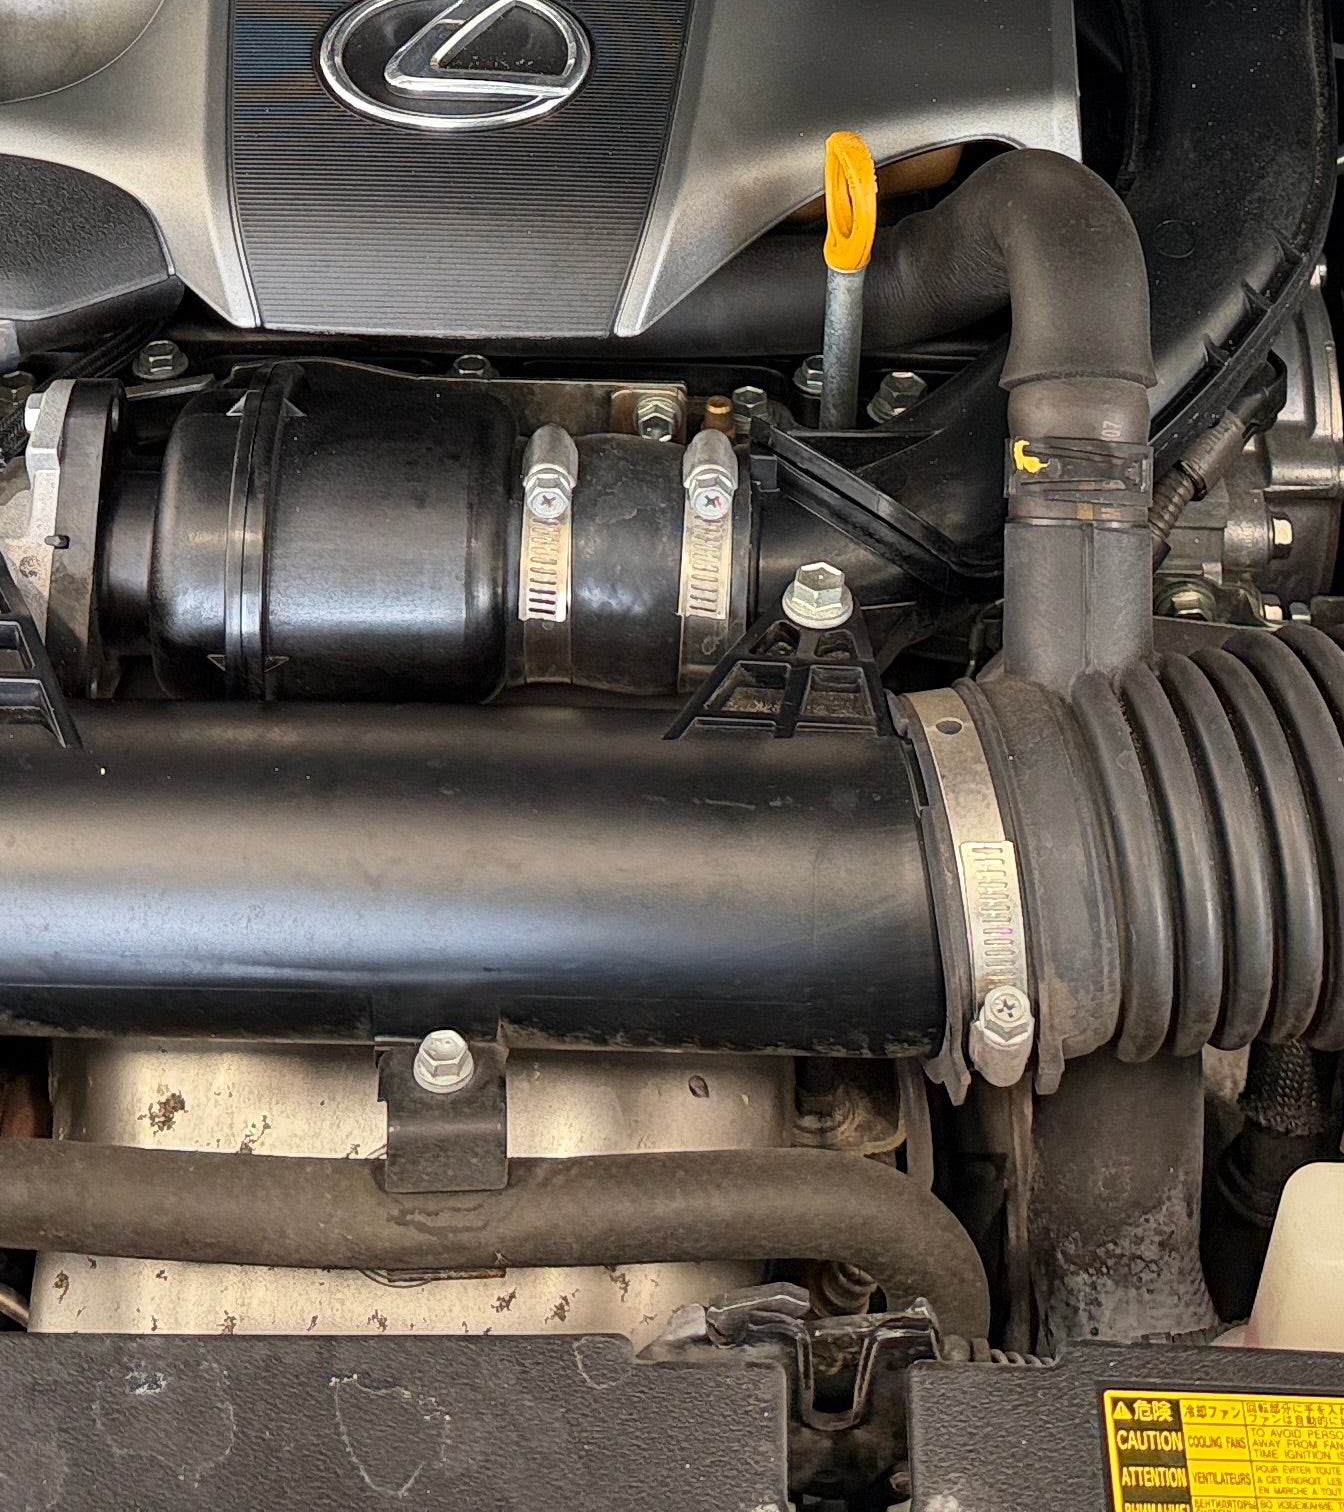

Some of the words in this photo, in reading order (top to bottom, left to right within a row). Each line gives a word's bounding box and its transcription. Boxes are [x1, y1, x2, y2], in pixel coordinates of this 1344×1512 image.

[1132, 1399, 1173, 1422] 危険
[1184, 1404, 1241, 1420] 冷却ファン
[1250, 1428, 1265, 1438] TO
[1270, 1428, 1302, 1439] AVOID
[1116, 1430, 1184, 1451] CAUTION
[1188, 1435, 1223, 1449] COOLING
[1226, 1436, 1247, 1450] FANS
[1252, 1439, 1281, 1448] AWAY
[1287, 1439, 1318, 1449] FROM
[1254, 1449, 1279, 1459] TIME
[1284, 1449, 1332, 1461] IGNITION
[1121, 1465, 1188, 1488] ATTENTION
[1256, 1464, 1278, 1474] POUR
[1316, 1466, 1342, 1476] TOUTE
[1192, 1471, 1253, 1486] VENTILATEURS
[1266, 1475, 1282, 1484] CET
[1322, 1488, 1343, 1497] TOUT
